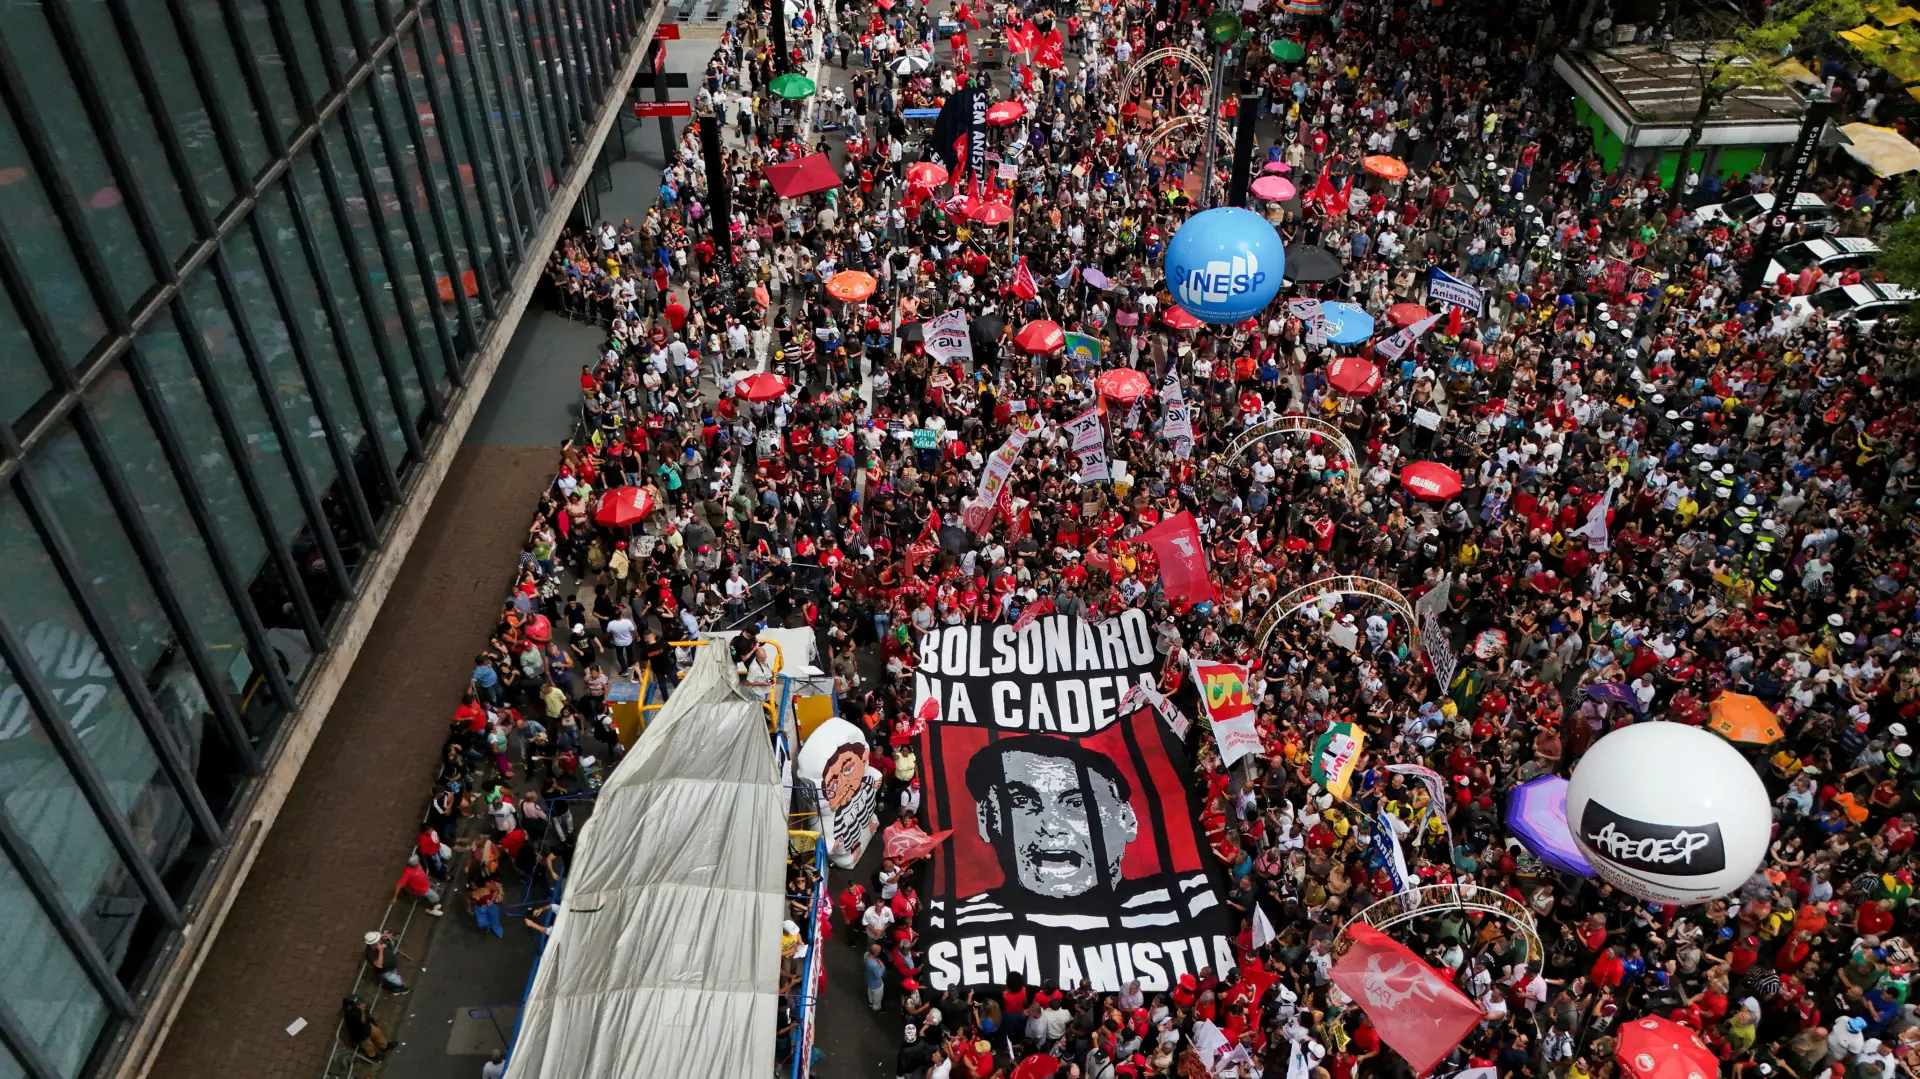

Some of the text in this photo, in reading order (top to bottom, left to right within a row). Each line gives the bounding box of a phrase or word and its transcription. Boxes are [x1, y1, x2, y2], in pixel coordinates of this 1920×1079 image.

[972, 92, 985, 184] SEM ANISTI
[1780, 126, 1820, 212] Al. Casa Branca
[1174, 265, 1266, 294] SINESP
[1432, 289, 1466, 305] Anistia
[1409, 476, 1440, 494] BRAHMA
[919, 608, 1155, 677] BOLSONARO
[913, 671, 977, 724] NA
[1373, 833, 1400, 886] Anistia
[1588, 822, 1709, 865] APEOESP
[1631, 881, 1647, 889] DOS
[928, 935, 1237, 993] SEM ANISTIA
